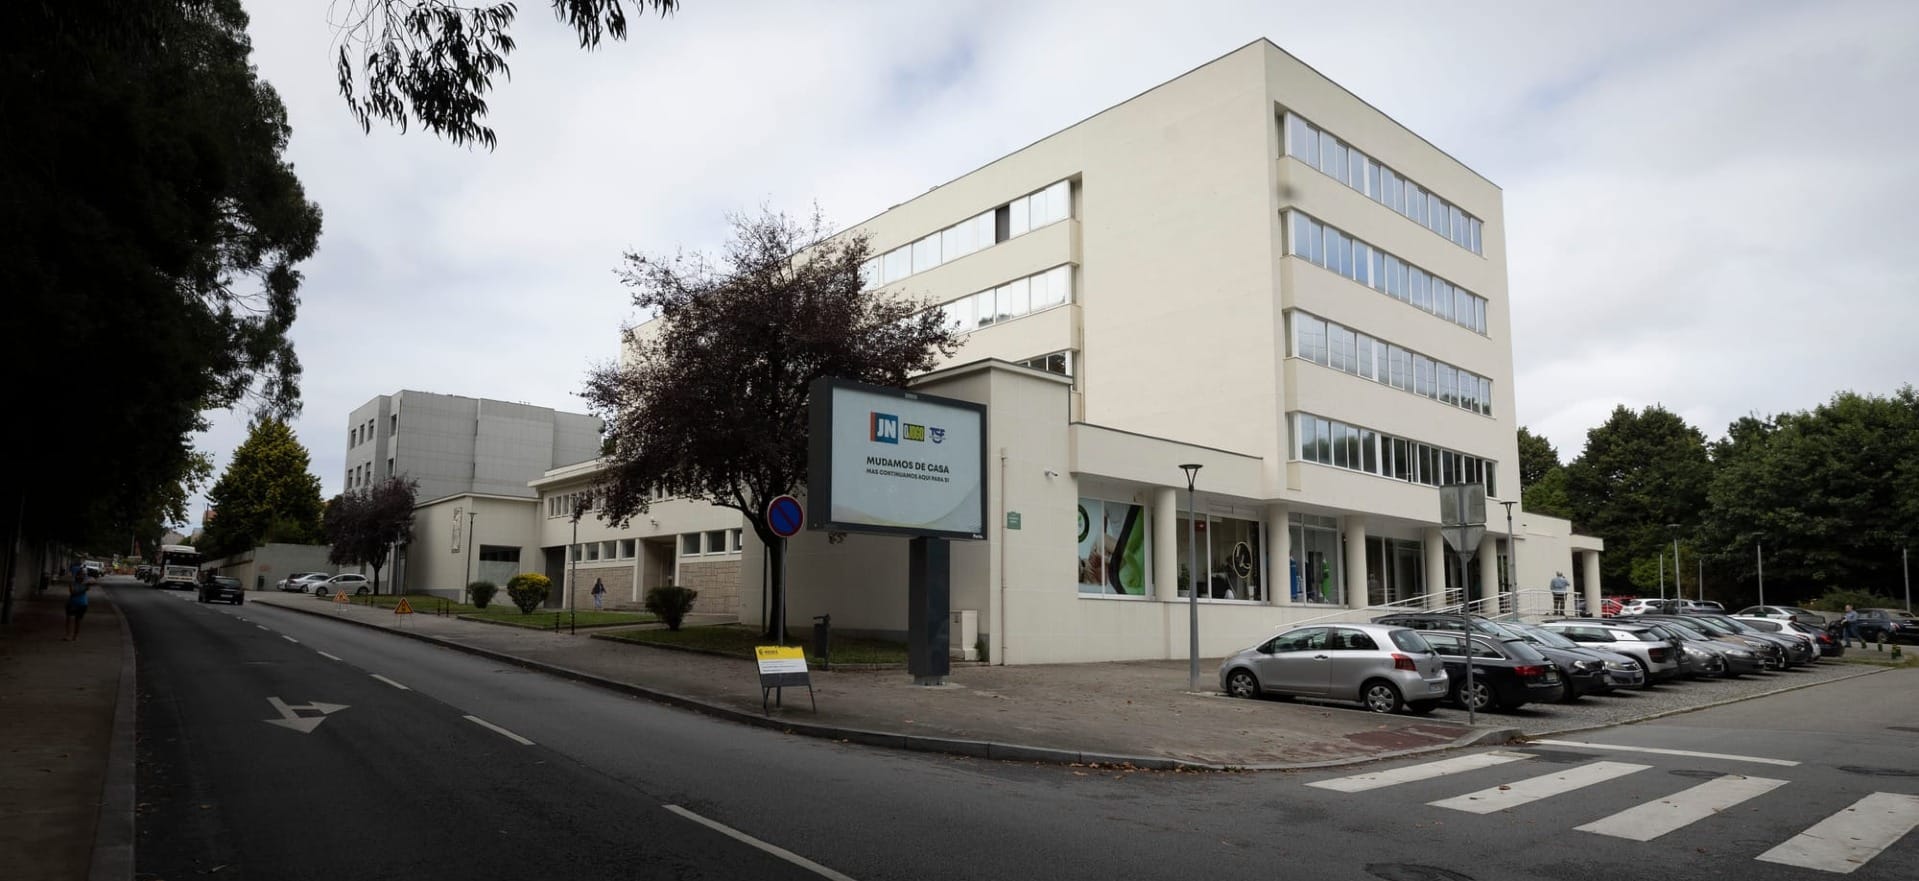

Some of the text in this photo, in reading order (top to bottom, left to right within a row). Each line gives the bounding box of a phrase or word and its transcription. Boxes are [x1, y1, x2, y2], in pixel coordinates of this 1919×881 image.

[877, 419, 896, 438] JN
[866, 456, 950, 474] MUDAMOS DE CASA
